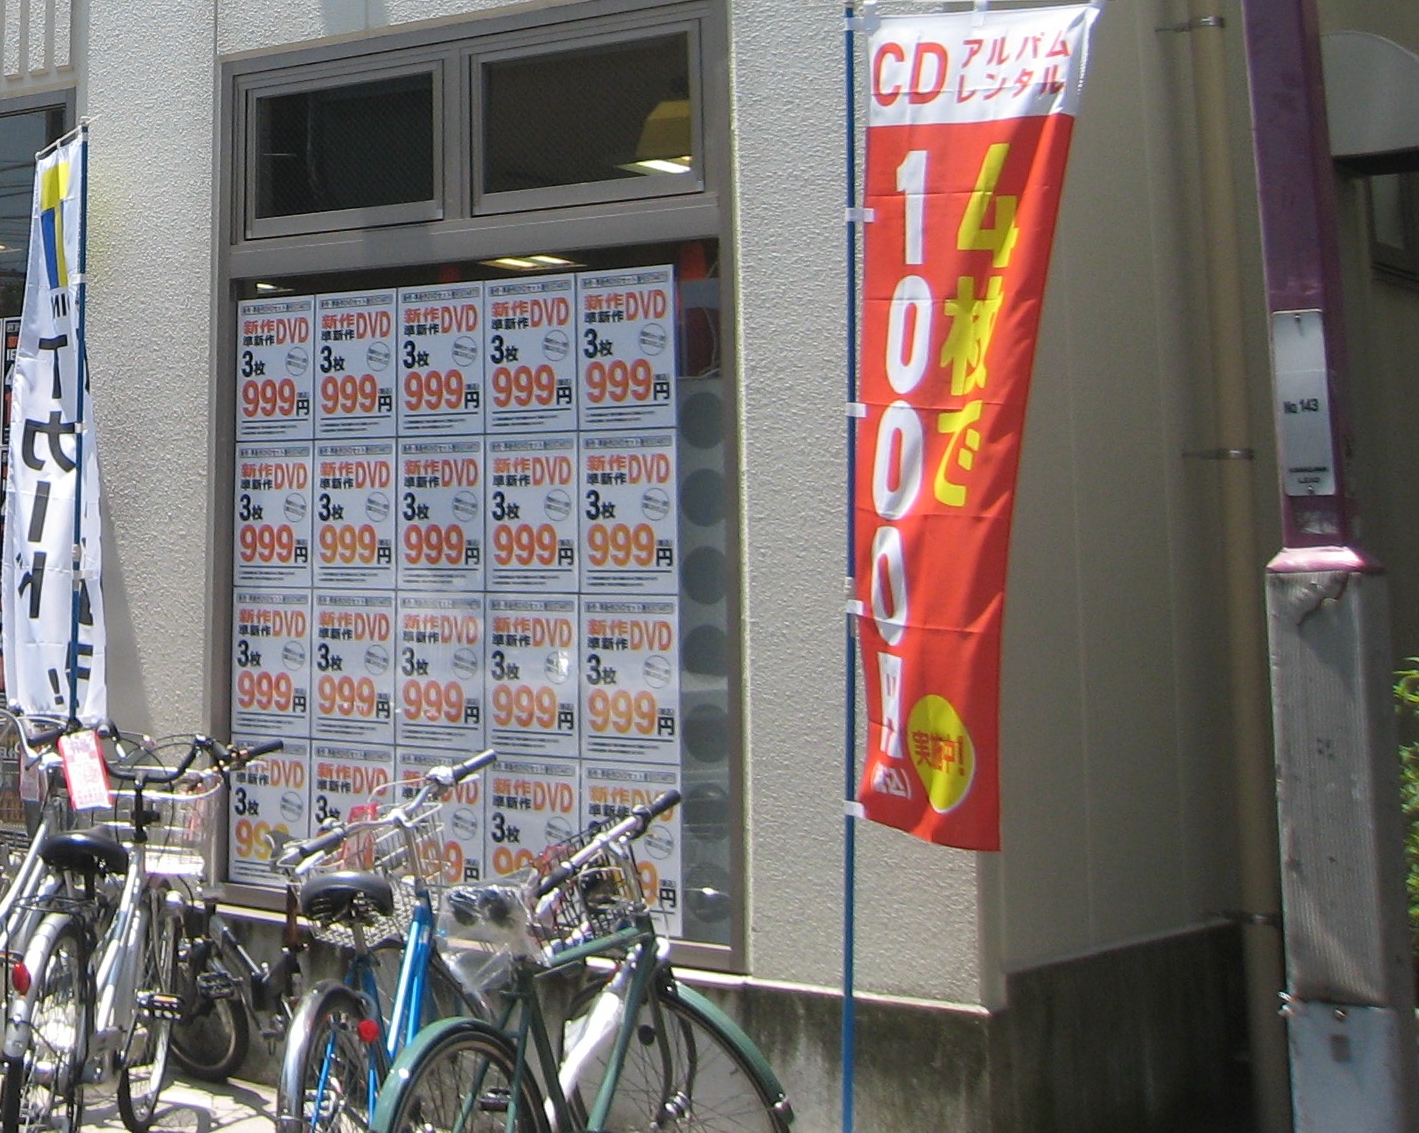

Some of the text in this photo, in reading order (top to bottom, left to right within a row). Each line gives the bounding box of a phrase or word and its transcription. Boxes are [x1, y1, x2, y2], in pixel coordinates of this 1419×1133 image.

[873, 31, 1071, 107] CD アルバム
[956, 64, 1066, 103] レンタル
[440, 303, 477, 334] DVD
[530, 296, 569, 328] DVD
[625, 289, 667, 321] DVD
[276, 316, 309, 345] DVD
[356, 310, 391, 339] DVD
[403, 339, 429, 369] 3枚
[490, 333, 518, 364] 3枚
[583, 327, 613, 359] 3枚
[242, 350, 265, 378] 3枚
[320, 345, 345, 374] 3枚
[274, 462, 307, 489] DVD
[354, 459, 390, 487] DVD
[440, 457, 477, 486] DVD
[530, 455, 570, 485] DVD
[626, 452, 669, 483] DVD
[240, 494, 264, 521] 3枚
[318, 492, 344, 521] 3枚
[402, 491, 428, 520] 3枚
[490, 490, 518, 520] 3枚
[584, 488, 614, 519] 3枚
[272, 609, 306, 637] DVD
[353, 611, 389, 640] DVD
[440, 613, 477, 643] DVD
[531, 615, 571, 646] DVD
[628, 618, 671, 650] DVD
[237, 639, 262, 668] 3枚
[317, 642, 342, 671] 3枚
[401, 645, 428, 675] 3枚
[490, 648, 519, 680] 3枚
[585, 652, 615, 684] 3枚
[270, 757, 304, 788] DVD
[352, 764, 388, 795] DVD
[235, 786, 260, 817] 3枚
[531, 778, 572, 811] DVD
[490, 809, 519, 843] 3枚
